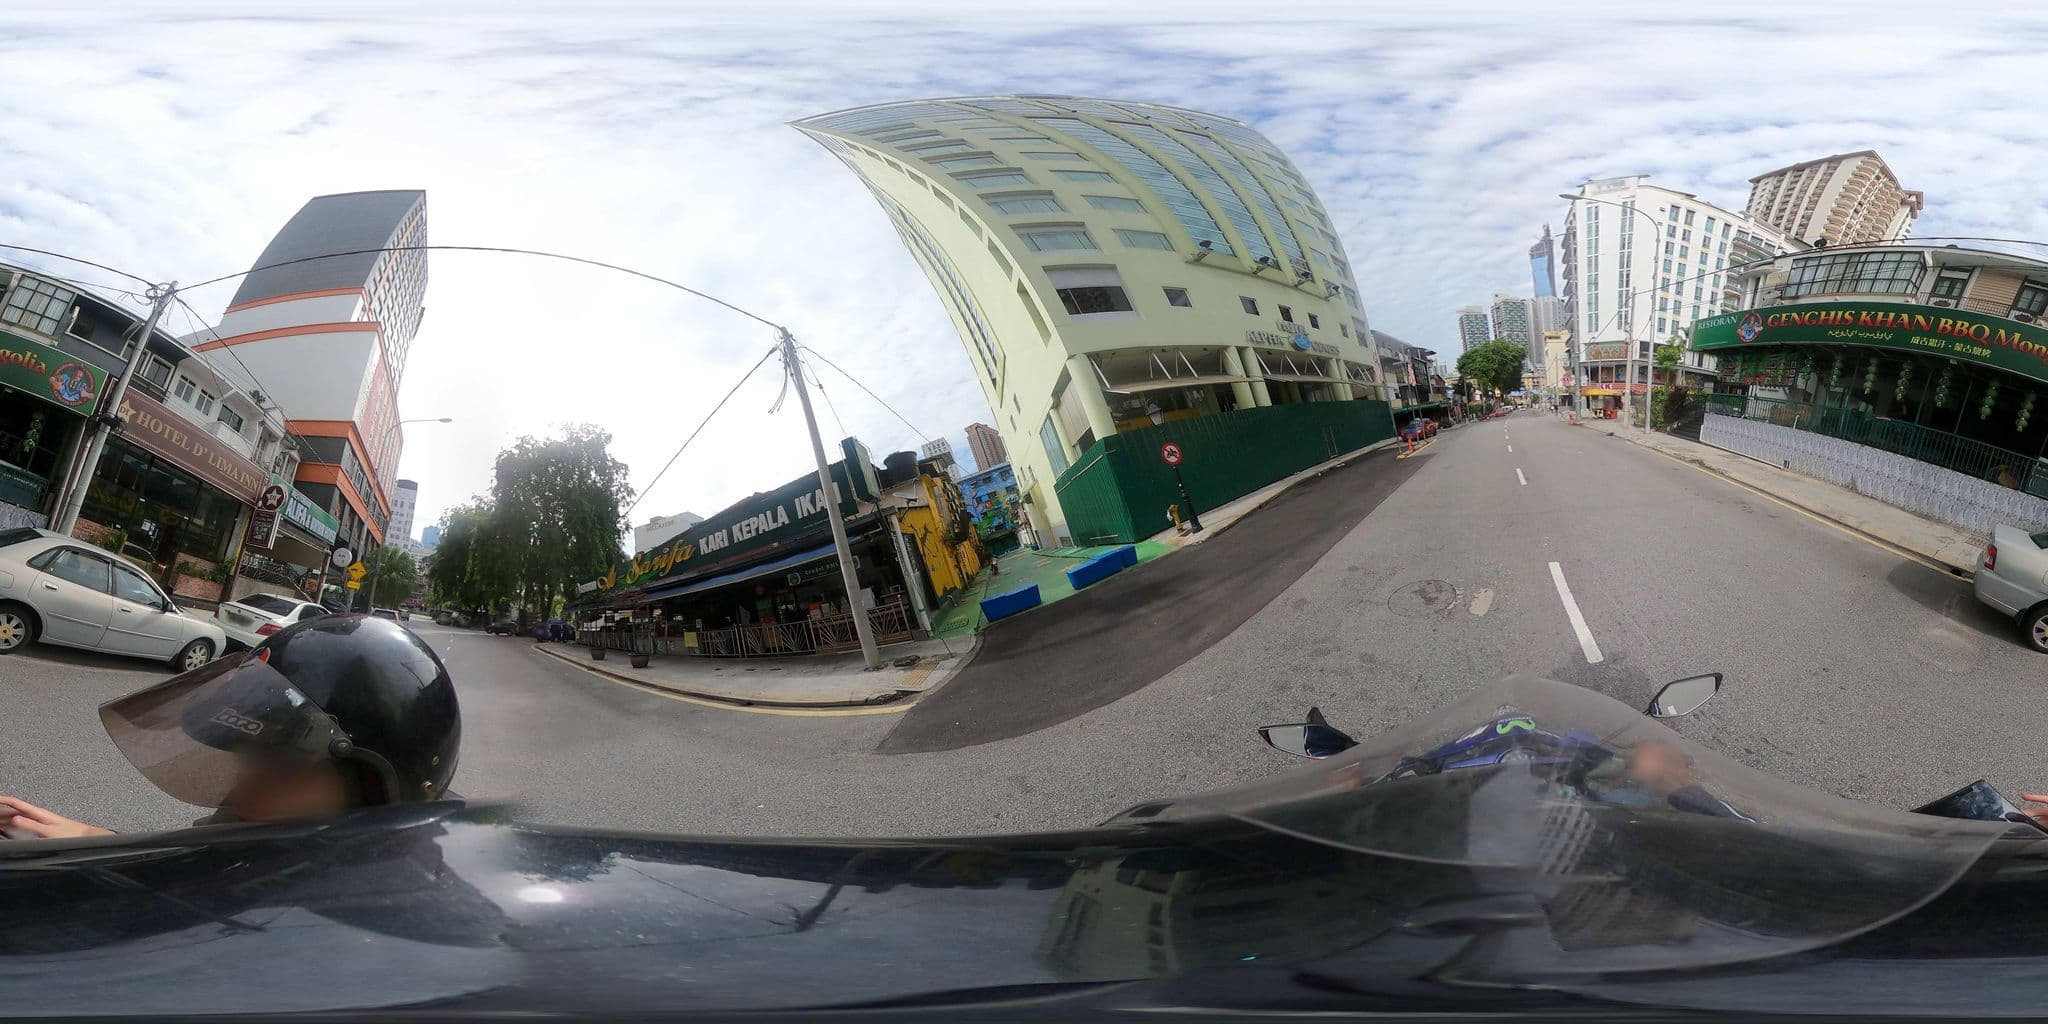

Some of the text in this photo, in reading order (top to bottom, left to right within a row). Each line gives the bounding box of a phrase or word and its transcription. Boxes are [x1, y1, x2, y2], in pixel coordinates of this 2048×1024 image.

[1697, 315, 1738, 330] RESTORAN
[1766, 310, 2048, 366] GENGHIS KHAN BBQ Mon
[136, 410, 191, 451] HOTEL
[208, 452, 240, 480] LIMA
[239, 474, 260, 492] INN
[699, 529, 729, 555] KARI
[732, 505, 790, 543] KEPALA
